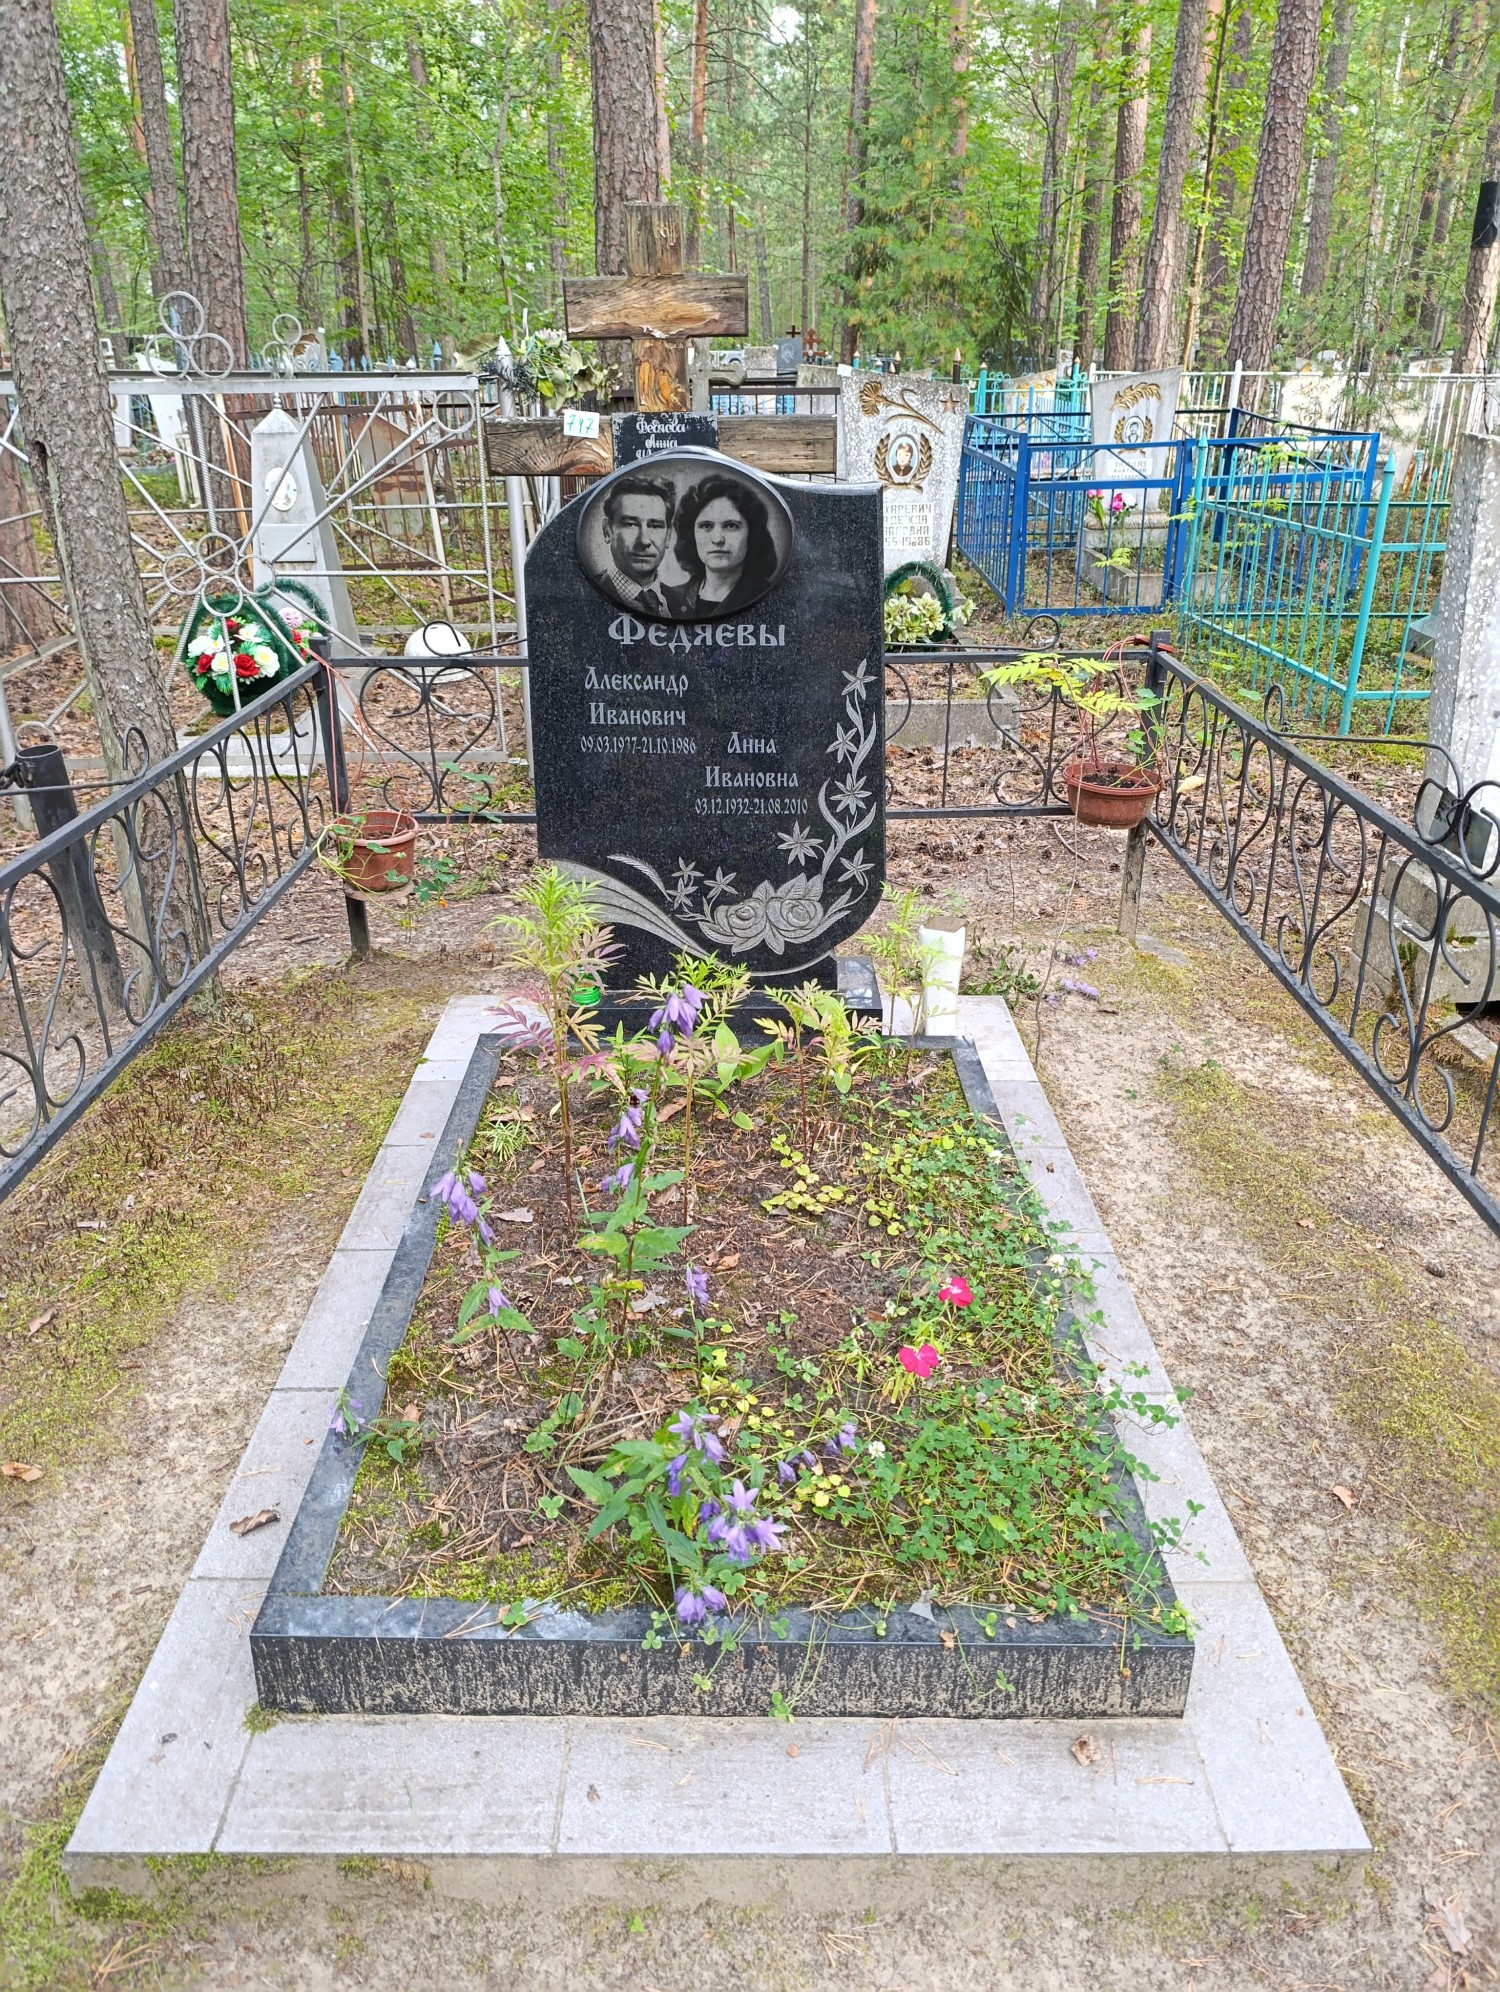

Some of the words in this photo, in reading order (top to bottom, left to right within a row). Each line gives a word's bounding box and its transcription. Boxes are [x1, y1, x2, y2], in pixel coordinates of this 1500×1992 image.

[608, 612, 785, 654] Федяевы
[585, 666, 689, 697] Александр
[589, 702, 686, 726] Иванович
[580, 735, 696, 754] 09.03.1937-21.10.1986
[727, 731, 777, 754] Анна
[705, 765, 799, 788] Ивановна
[695, 797, 808, 815] 03.12.1932-21.08.2010
